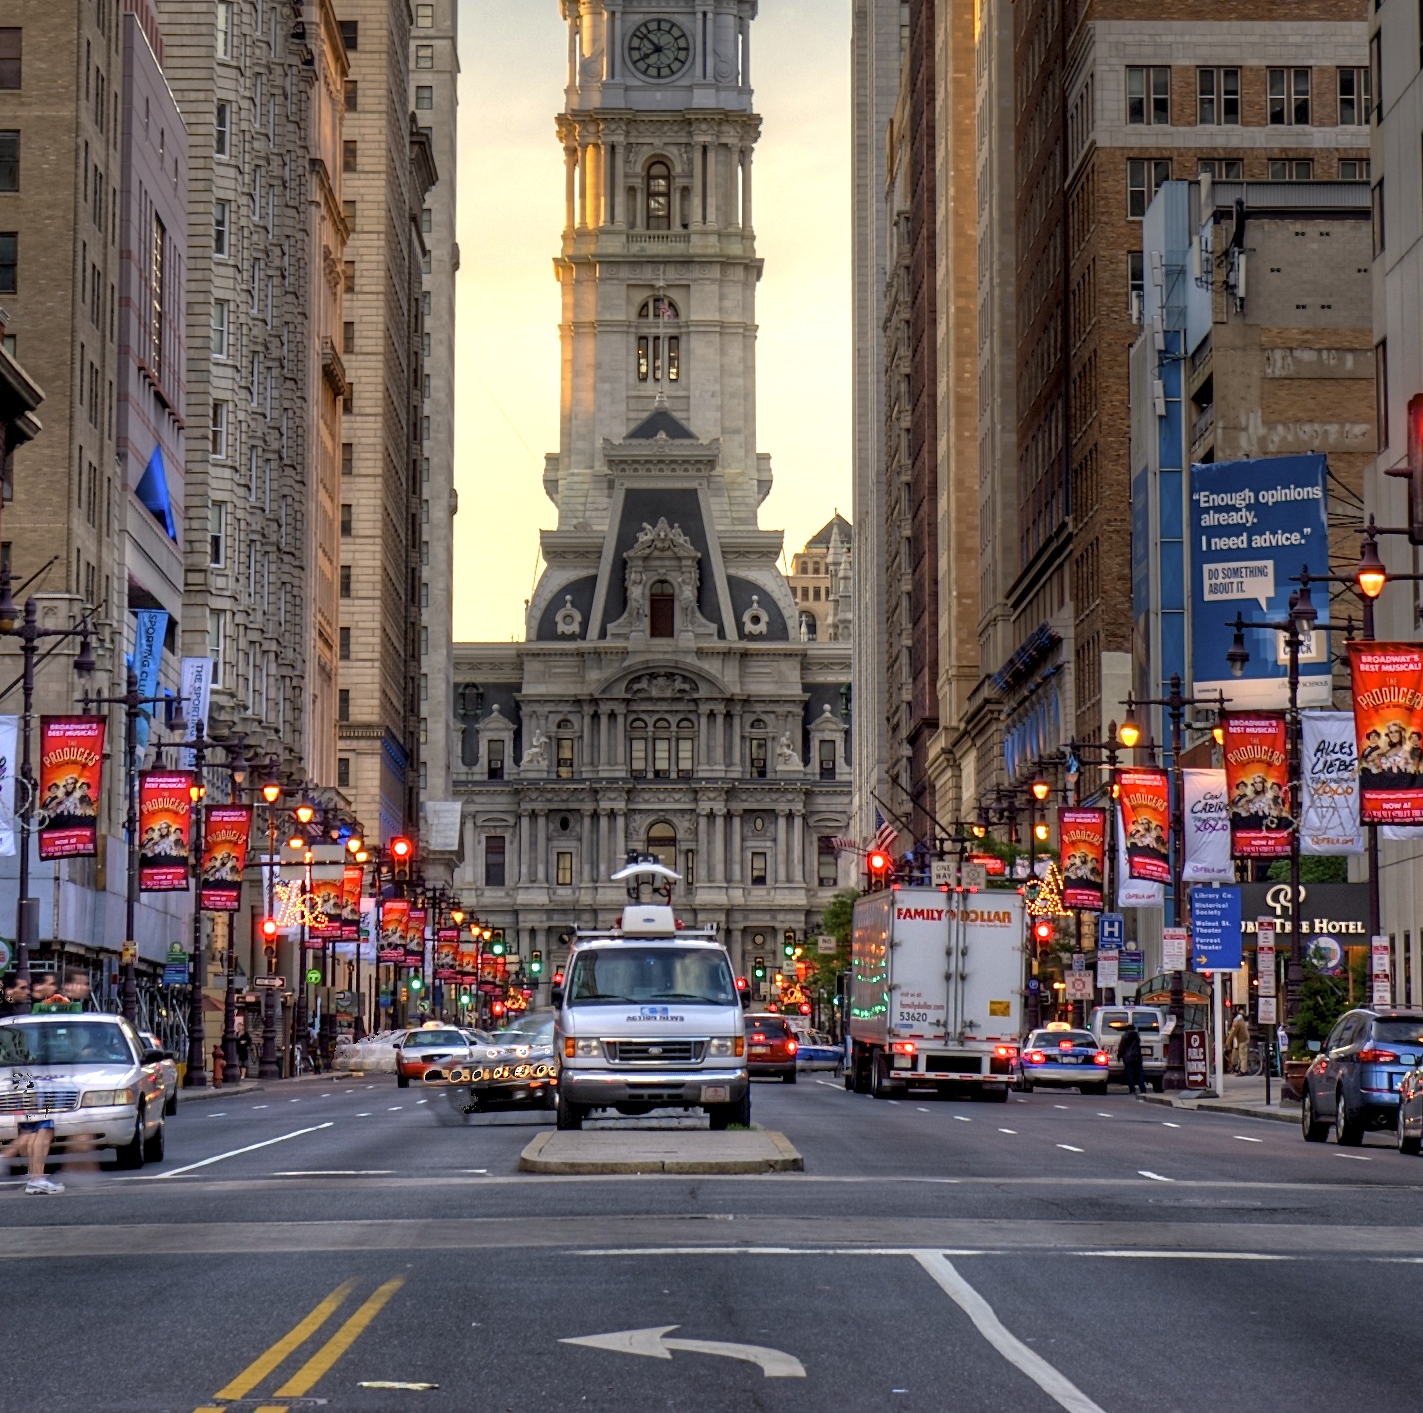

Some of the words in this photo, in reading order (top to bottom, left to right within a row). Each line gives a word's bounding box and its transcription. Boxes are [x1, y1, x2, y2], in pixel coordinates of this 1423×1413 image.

[1193, 487, 1255, 508] “Enough
[1258, 484, 1323, 506] opinions
[1201, 508, 1258, 527] already.
[1201, 535, 1207, 551] I
[1211, 532, 1248, 550] need
[1251, 527, 1312, 548] advice.”
[1208, 568, 1220, 581] DO
[1221, 565, 1268, 580] SOMETHING
[1208, 581, 1234, 595] ABOUT
[1236, 581, 1246, 594] IT.
[139, 613, 158, 669] SPORTING
[1360, 654, 1420, 663] BROADWAY'S
[193, 664, 204, 684] THE
[1359, 663, 1379, 672] BEST
[1386, 677, 1397, 685] THE
[1226, 745, 1285, 766] PRODUCERS
[1313, 739, 1354, 758] ALLES
[1310, 757, 1358, 775] LIEBE
[936, 872, 952, 880] WAY
[1194, 892, 1220, 900] Library
[896, 908, 944, 922] FAMILY
[960, 909, 1012, 924] DOLLAR
[1195, 909, 1221, 917] Society
[1104, 921, 1119, 938] H
[1314, 918, 1366, 934] HOTEL
[899, 1011, 928, 1022] 53620
